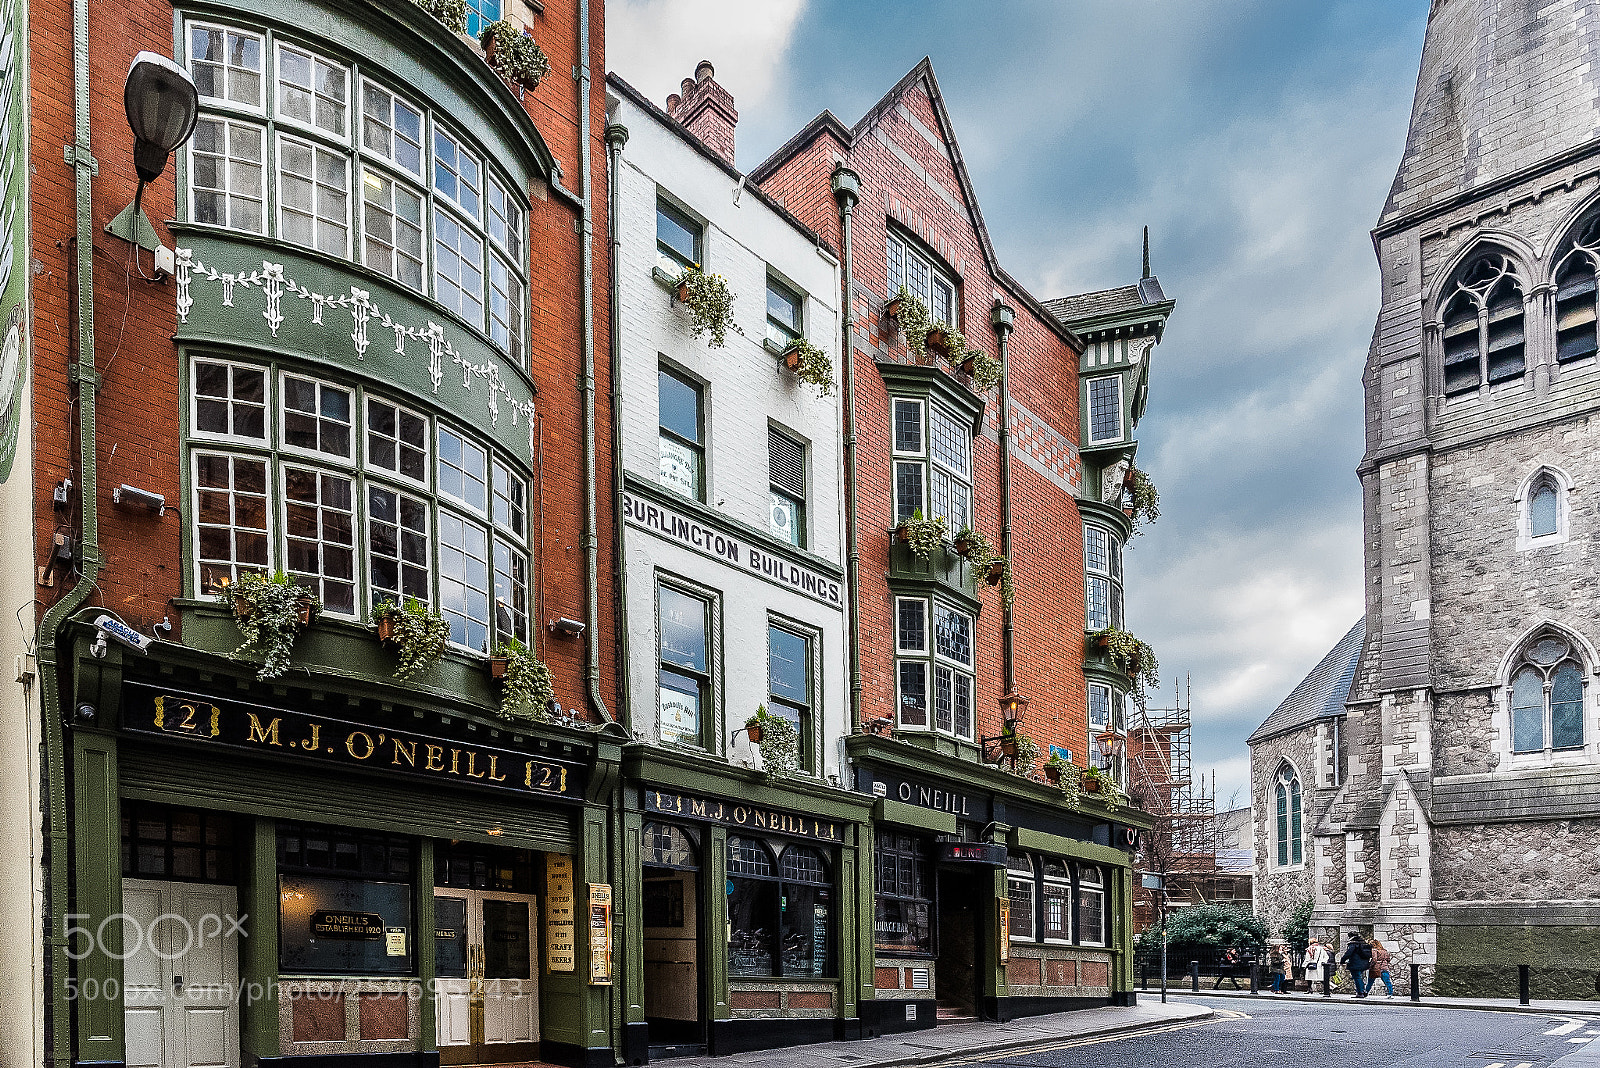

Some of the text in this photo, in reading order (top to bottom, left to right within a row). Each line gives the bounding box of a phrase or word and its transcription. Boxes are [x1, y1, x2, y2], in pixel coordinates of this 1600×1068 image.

[624, 494, 739, 562] BURLINGTON
[180, 704, 197, 730] 2
[345, 731, 506, 781] O'NEILL
[539, 767, 552, 787] 2
[899, 781, 970, 816] O'NEILL
[733, 806, 808, 835] O'NEILL
[315, 924, 381, 934] ESTABLISHED 1920
[325, 915, 368, 926] O'NEILL'S
